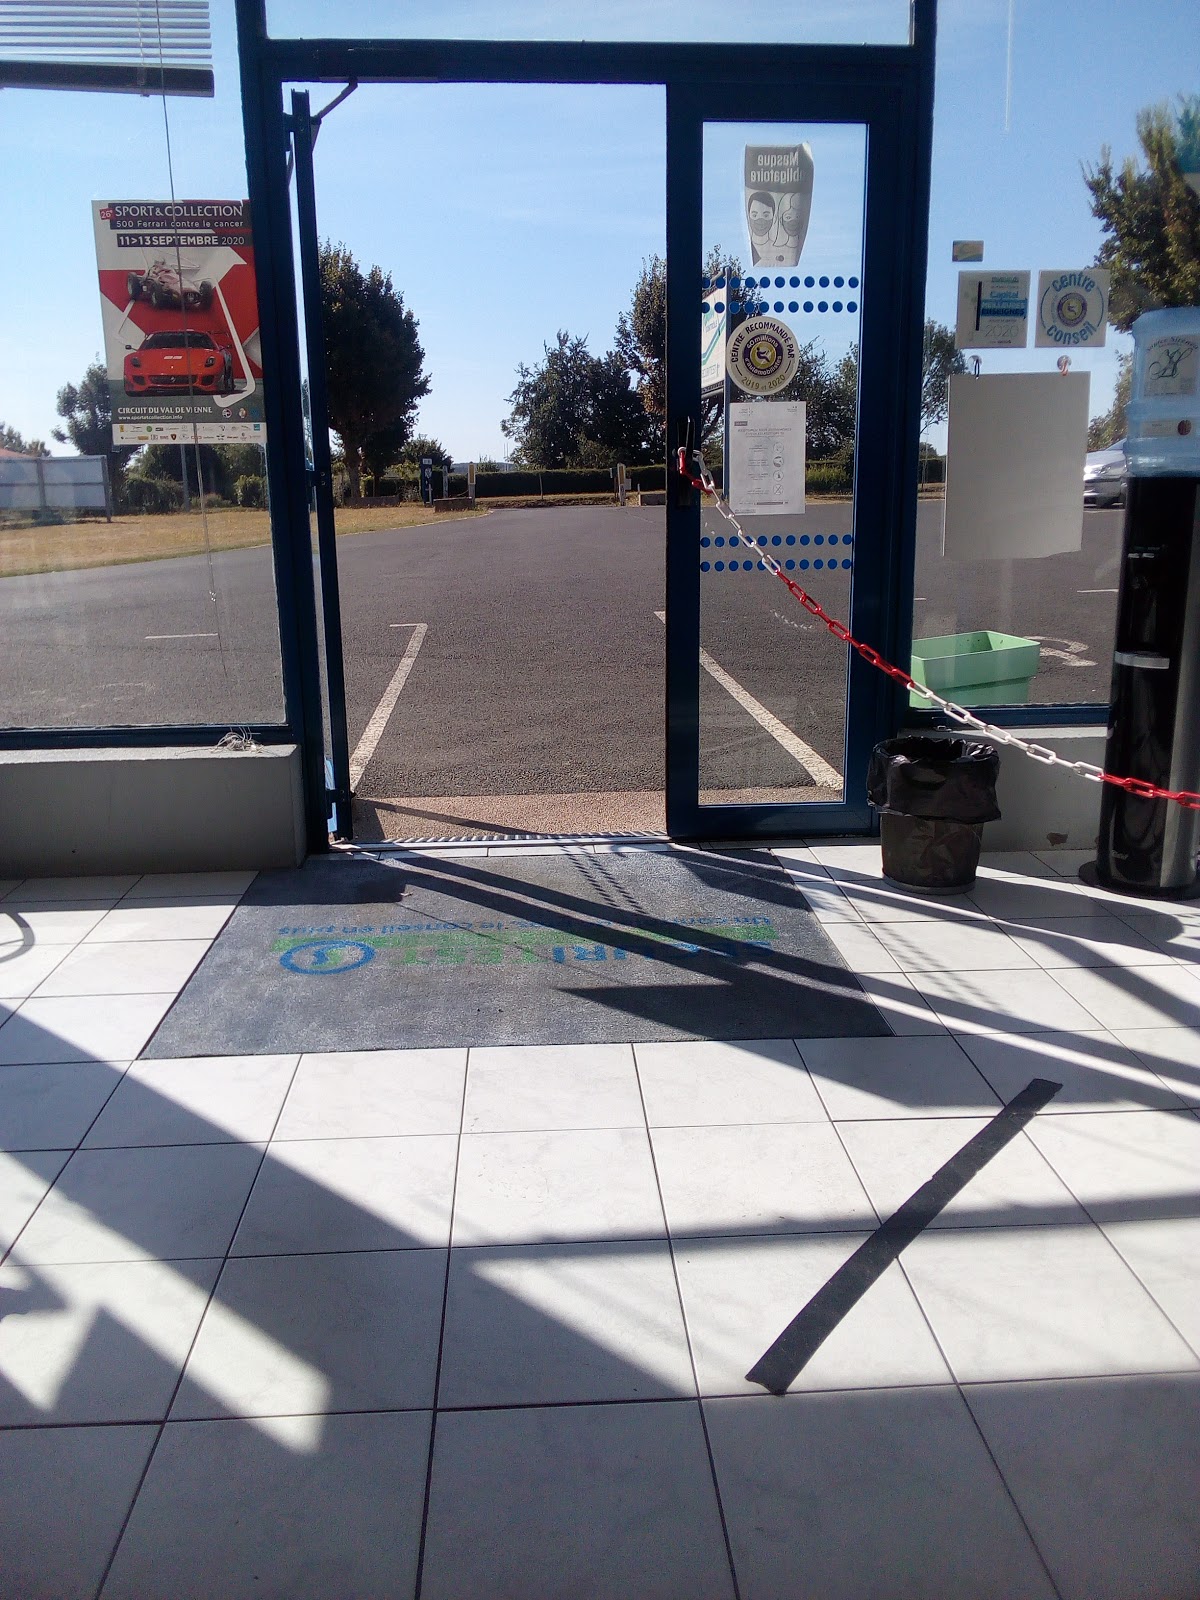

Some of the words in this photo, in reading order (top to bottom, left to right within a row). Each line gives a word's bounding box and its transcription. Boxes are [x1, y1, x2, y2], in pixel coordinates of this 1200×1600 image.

[116, 220, 134, 228] 500
[137, 220, 168, 228] Ferrari
[170, 220, 200, 228] contre
[203, 220, 211, 228] le
[214, 220, 244, 228] cancer
[152, 236, 219, 246] SEPTEMBRE
[221, 236, 245, 245] 2020
[1052, 270, 1096, 292] centre
[981, 308, 1025, 316] ENSEIGNES
[985, 324, 1020, 338] 2020
[1047, 320, 1097, 345] conseil
[731, 333, 746, 363] CENTRE
[745, 321, 792, 344] RECOMMANDÉ
[786, 343, 795, 359] PAR
[754, 334, 779, 348] millions
[741, 376, 760, 390] 2019
[767, 374, 786, 390] 2020
[118, 406, 148, 415] CIRCUIT
[148, 406, 159, 414] DU
[160, 406, 174, 414] VAL
[175, 406, 185, 414] DE
[185, 406, 213, 414] VIENNE
[277, 925, 337, 937] plus
